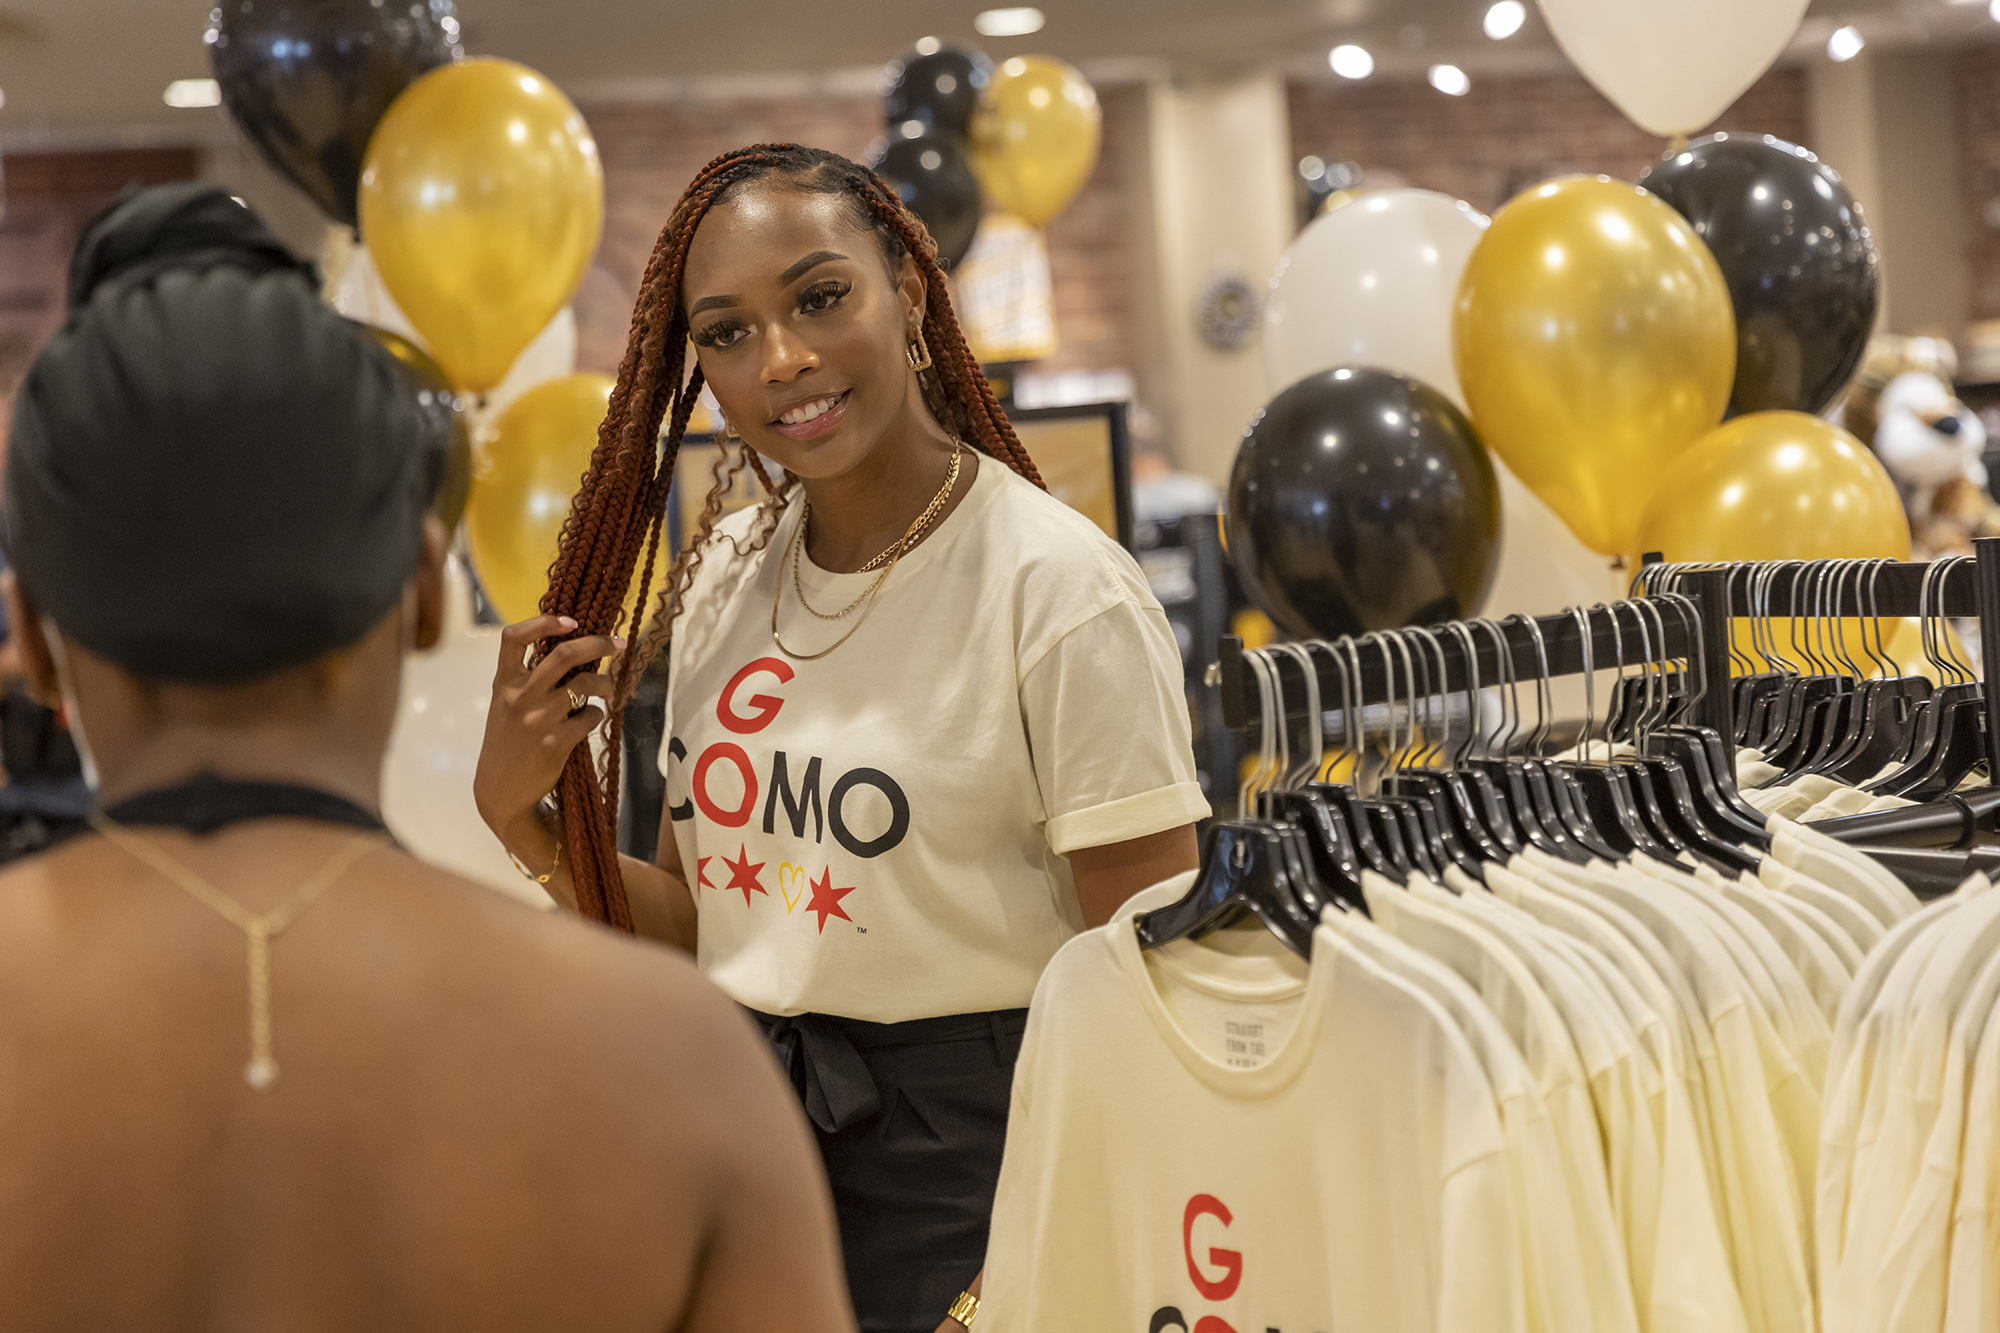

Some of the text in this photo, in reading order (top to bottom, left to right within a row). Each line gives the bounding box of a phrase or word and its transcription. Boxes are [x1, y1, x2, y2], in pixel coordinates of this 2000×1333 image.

[716, 656, 795, 735] G
[857, 926, 867, 935] TM
[1183, 1193, 1243, 1302] G
